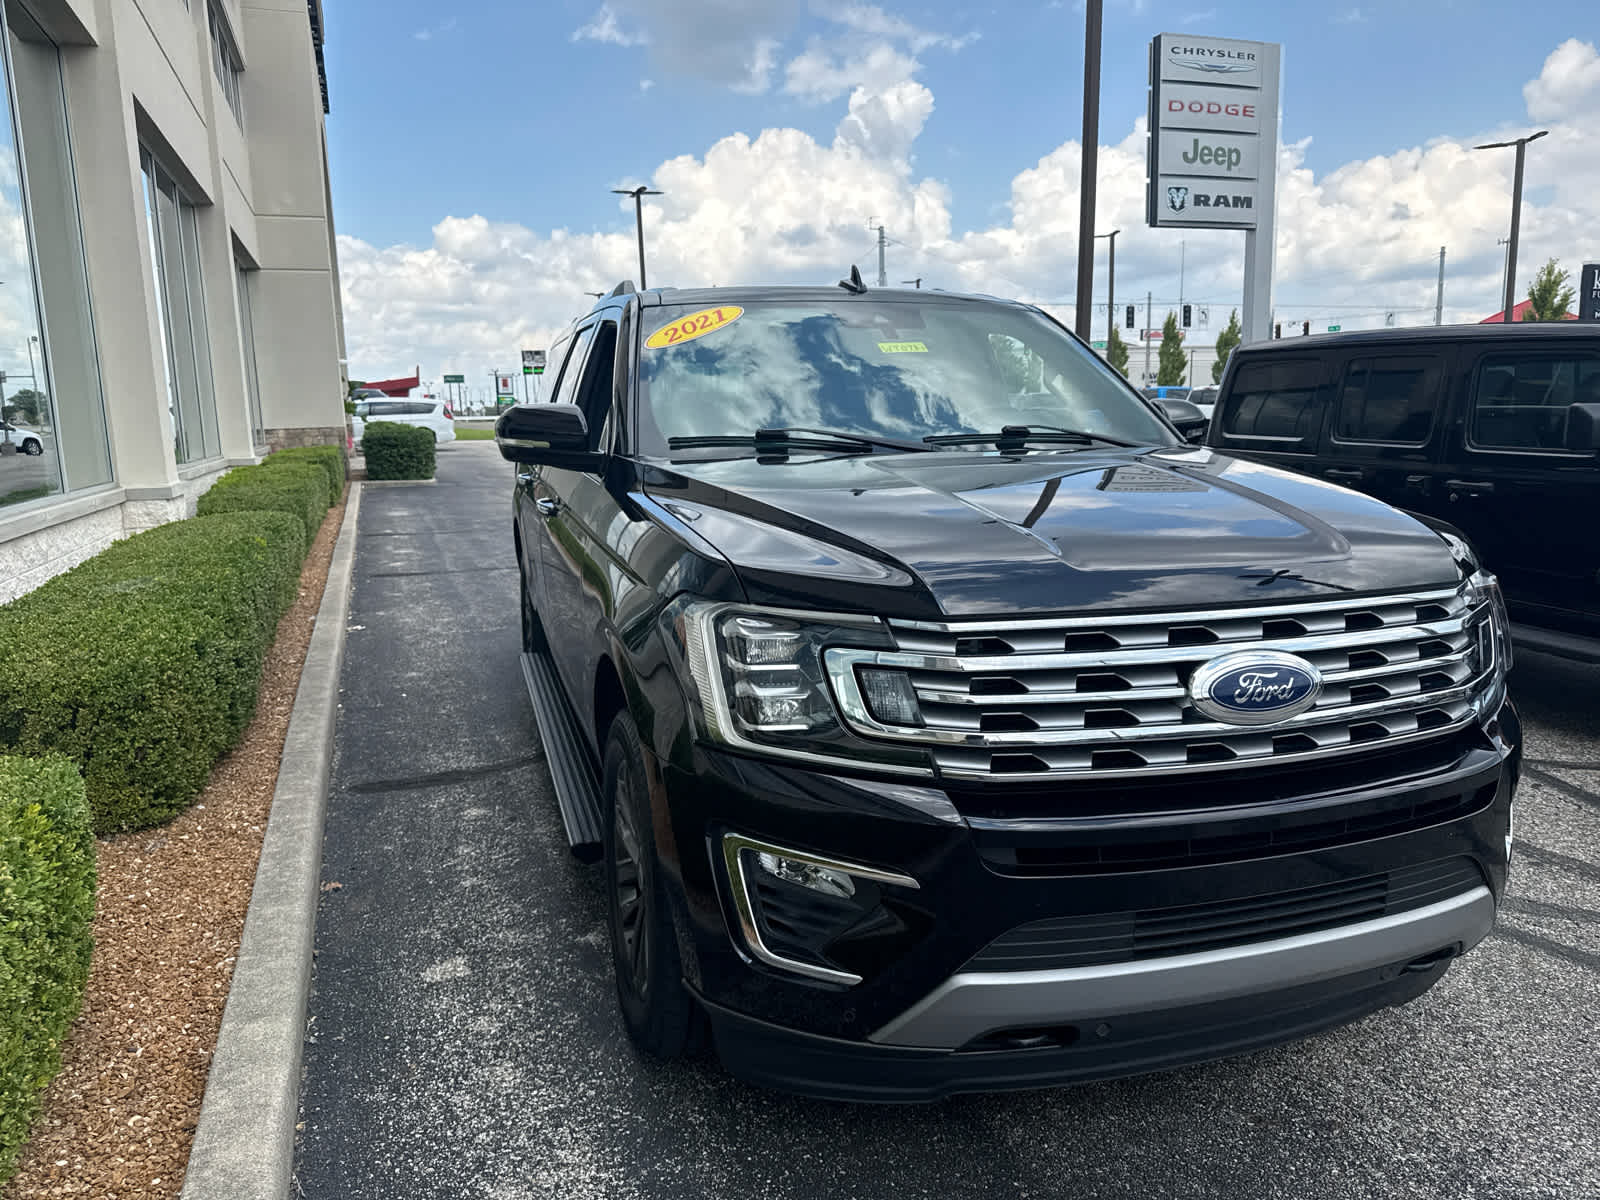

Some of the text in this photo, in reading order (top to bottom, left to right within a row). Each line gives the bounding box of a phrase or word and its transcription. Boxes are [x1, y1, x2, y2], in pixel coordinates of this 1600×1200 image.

[1170, 46, 1256, 61] CHRYSLER
[1168, 100, 1256, 118] DODGE
[1182, 138, 1241, 171] Jeep
[1193, 194, 1253, 209] RAM
[664, 309, 727, 343] 2021
[1234, 671, 1295, 704] Ford
